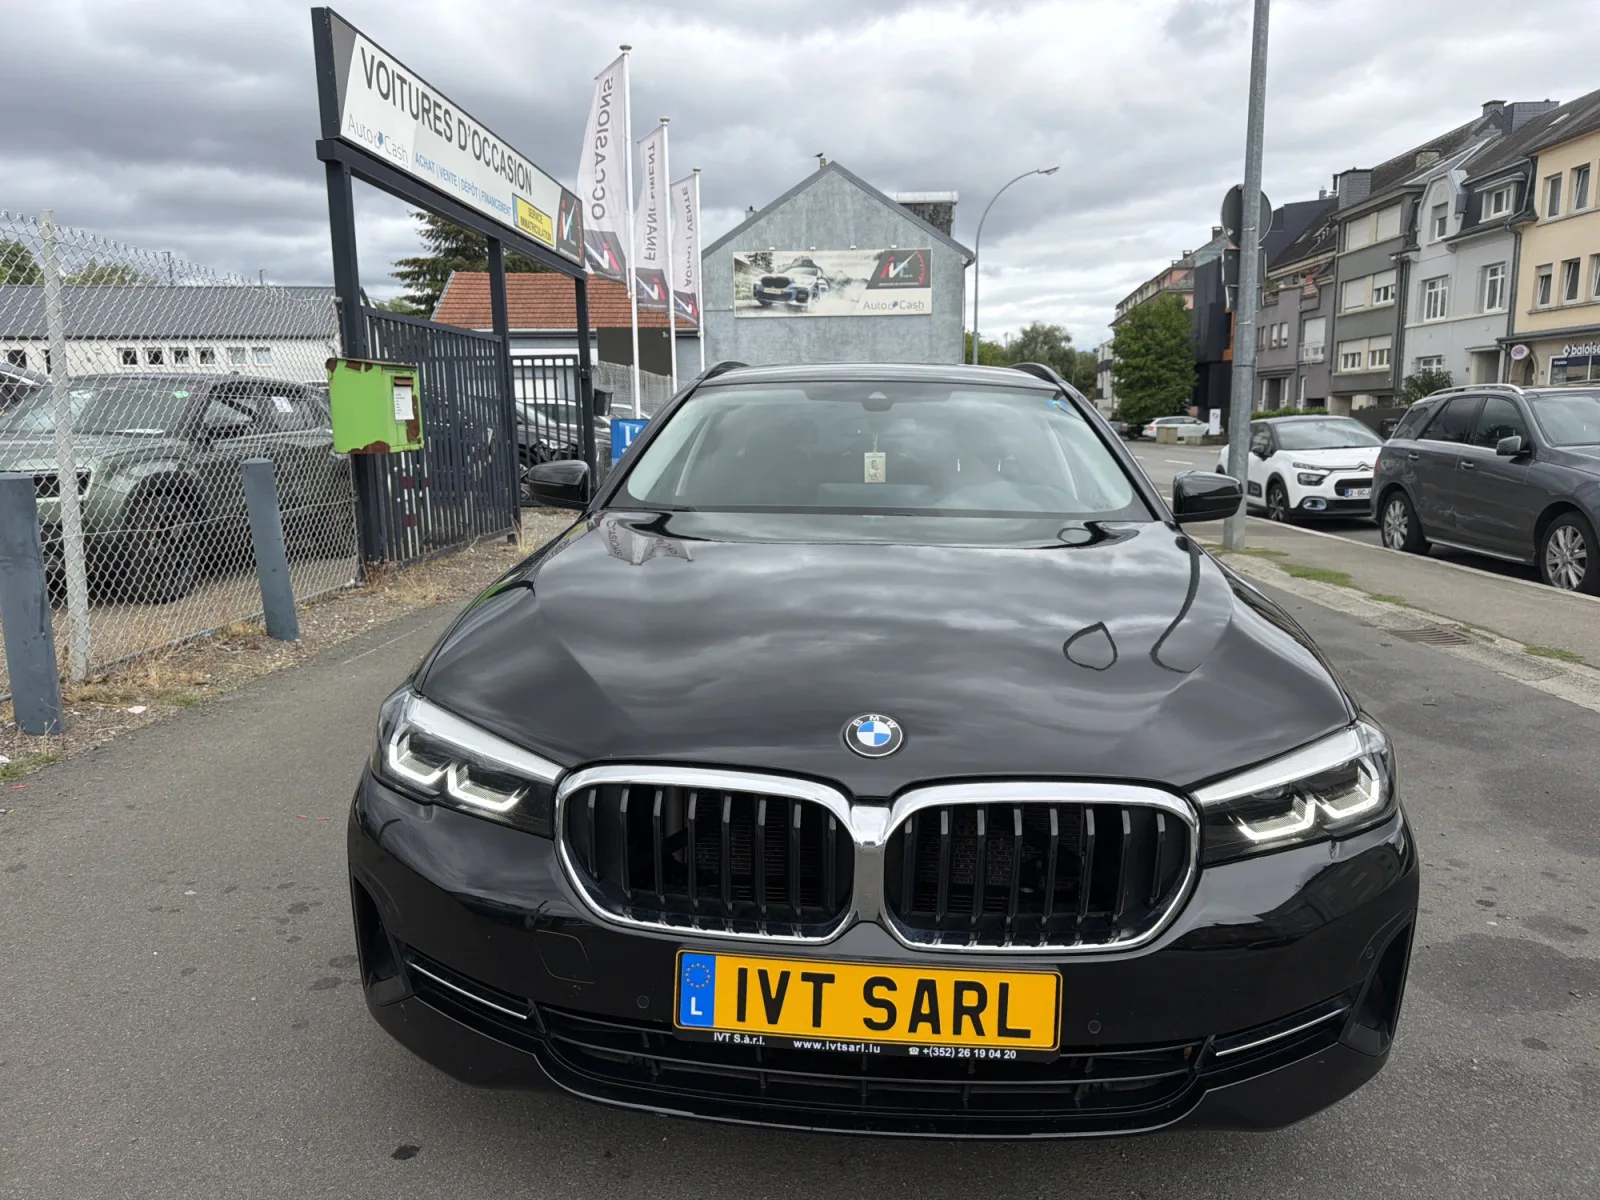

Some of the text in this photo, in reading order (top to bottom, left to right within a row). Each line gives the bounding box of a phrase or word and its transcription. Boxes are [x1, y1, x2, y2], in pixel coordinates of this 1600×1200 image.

[360, 46, 533, 196] VOITURES D'OCCASION
[348, 113, 409, 162] Auto Cash
[415, 152, 436, 174] ACHAT
[438, 165, 458, 187] VENTE
[863, 299, 925, 310] Auto Cash
[1571, 341, 1600, 356] baloise
[852, 714, 898, 729] BMW
[690, 996, 703, 1016] L
[736, 967, 1032, 1040] IVT SARL
[713, 1032, 766, 1046] IVT S.à.r.l.
[793, 1040, 881, 1054] www.ivtsarl.lu
[922, 1046, 1017, 1060] +(352) 26 19 04 20
